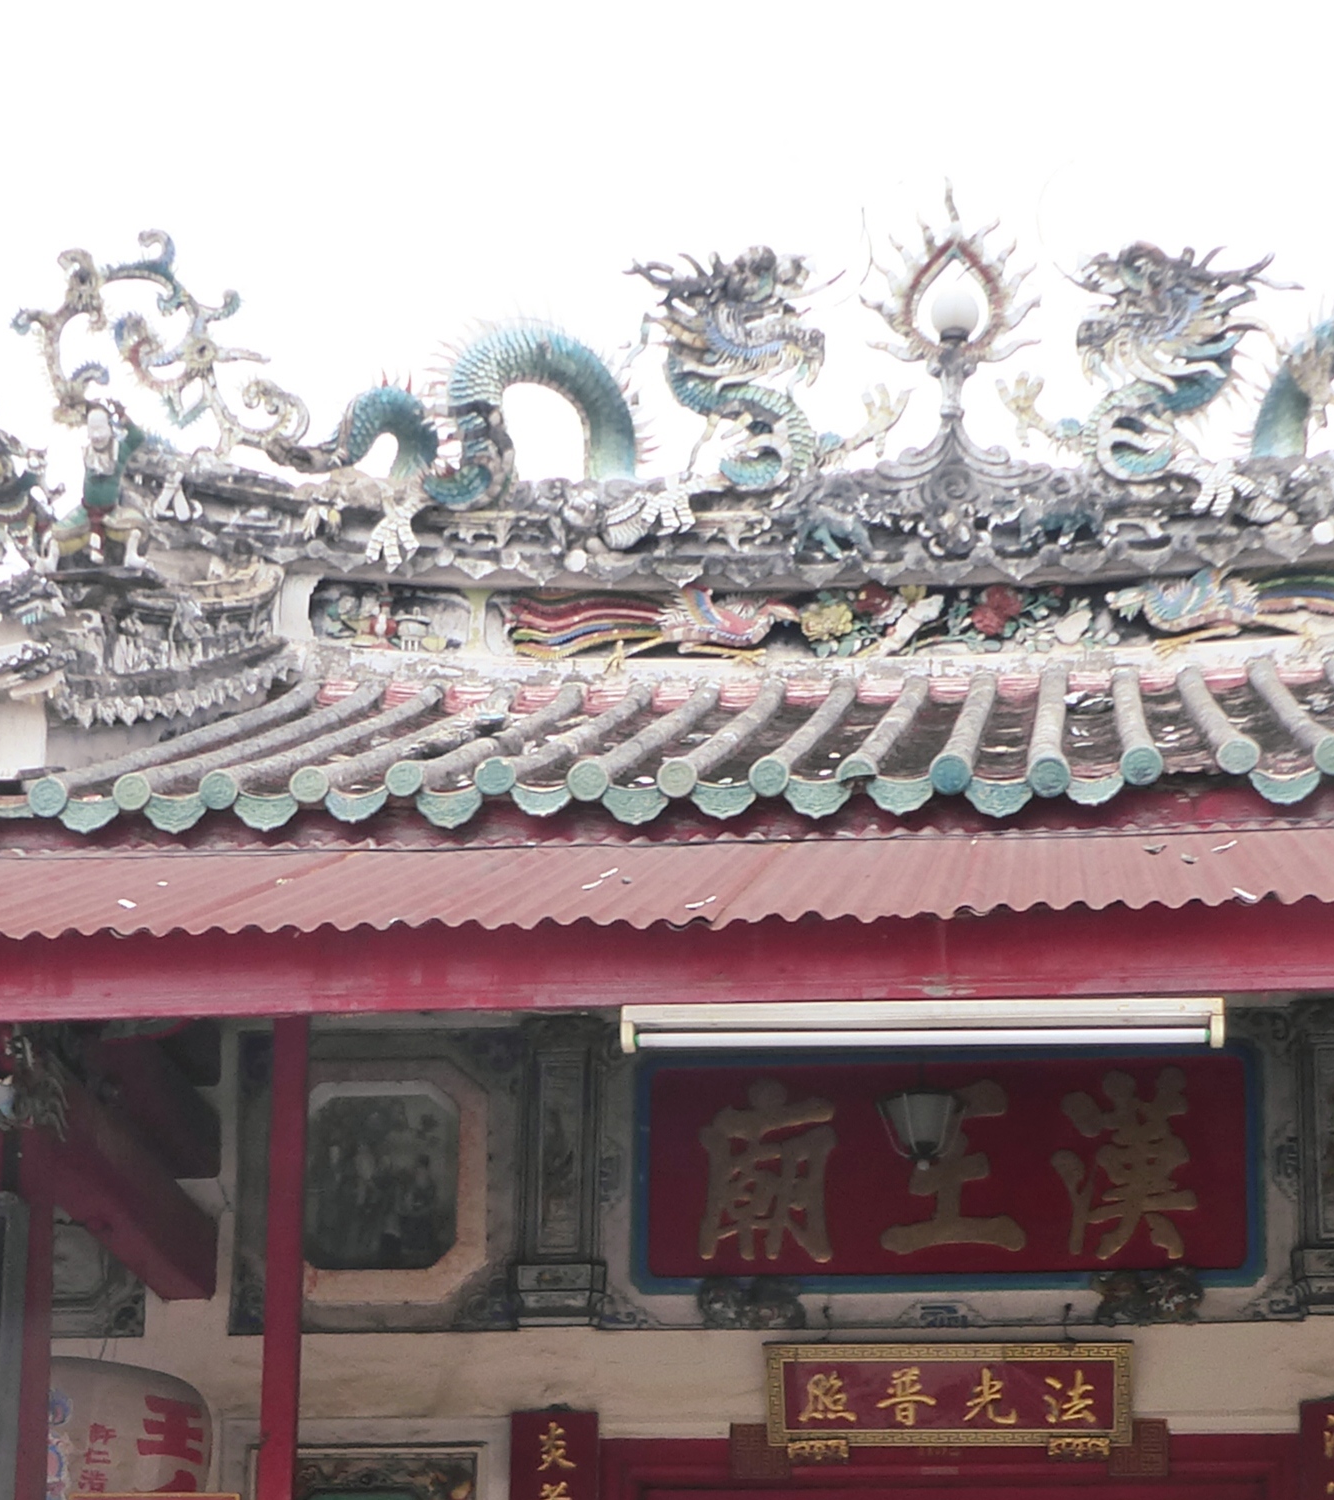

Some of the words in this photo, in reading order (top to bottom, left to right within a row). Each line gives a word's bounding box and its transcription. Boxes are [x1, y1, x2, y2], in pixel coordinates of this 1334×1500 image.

[697, 1066, 1198, 1262] 漢王廟
[797, 1367, 1097, 1427] 法光普照
